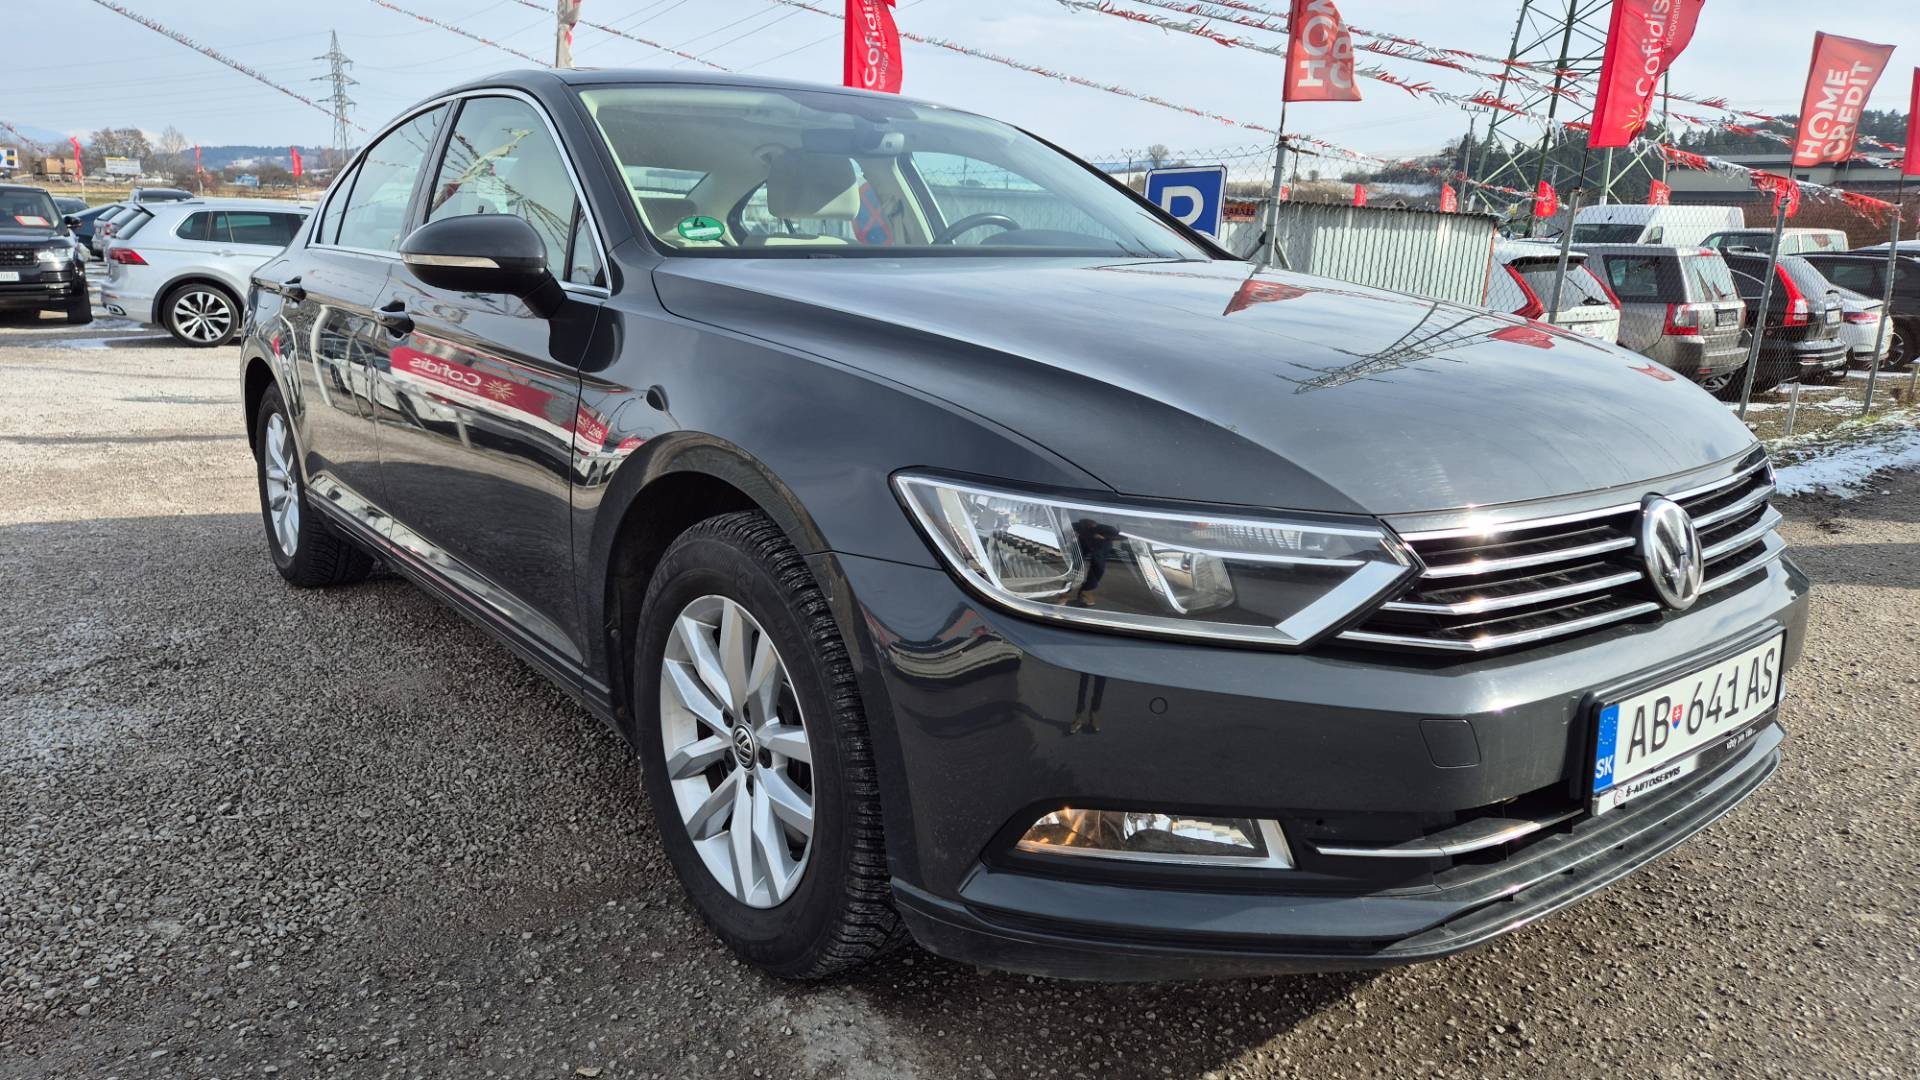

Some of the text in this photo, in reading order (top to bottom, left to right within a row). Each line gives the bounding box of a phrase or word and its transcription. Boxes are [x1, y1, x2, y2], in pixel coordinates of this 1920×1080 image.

[1798, 68, 1849, 158] HOME
[1823, 60, 1873, 157] CREDIT
[1161, 185, 1204, 227] P
[1626, 695, 1671, 765] AB
[1595, 756, 1614, 779] SK
